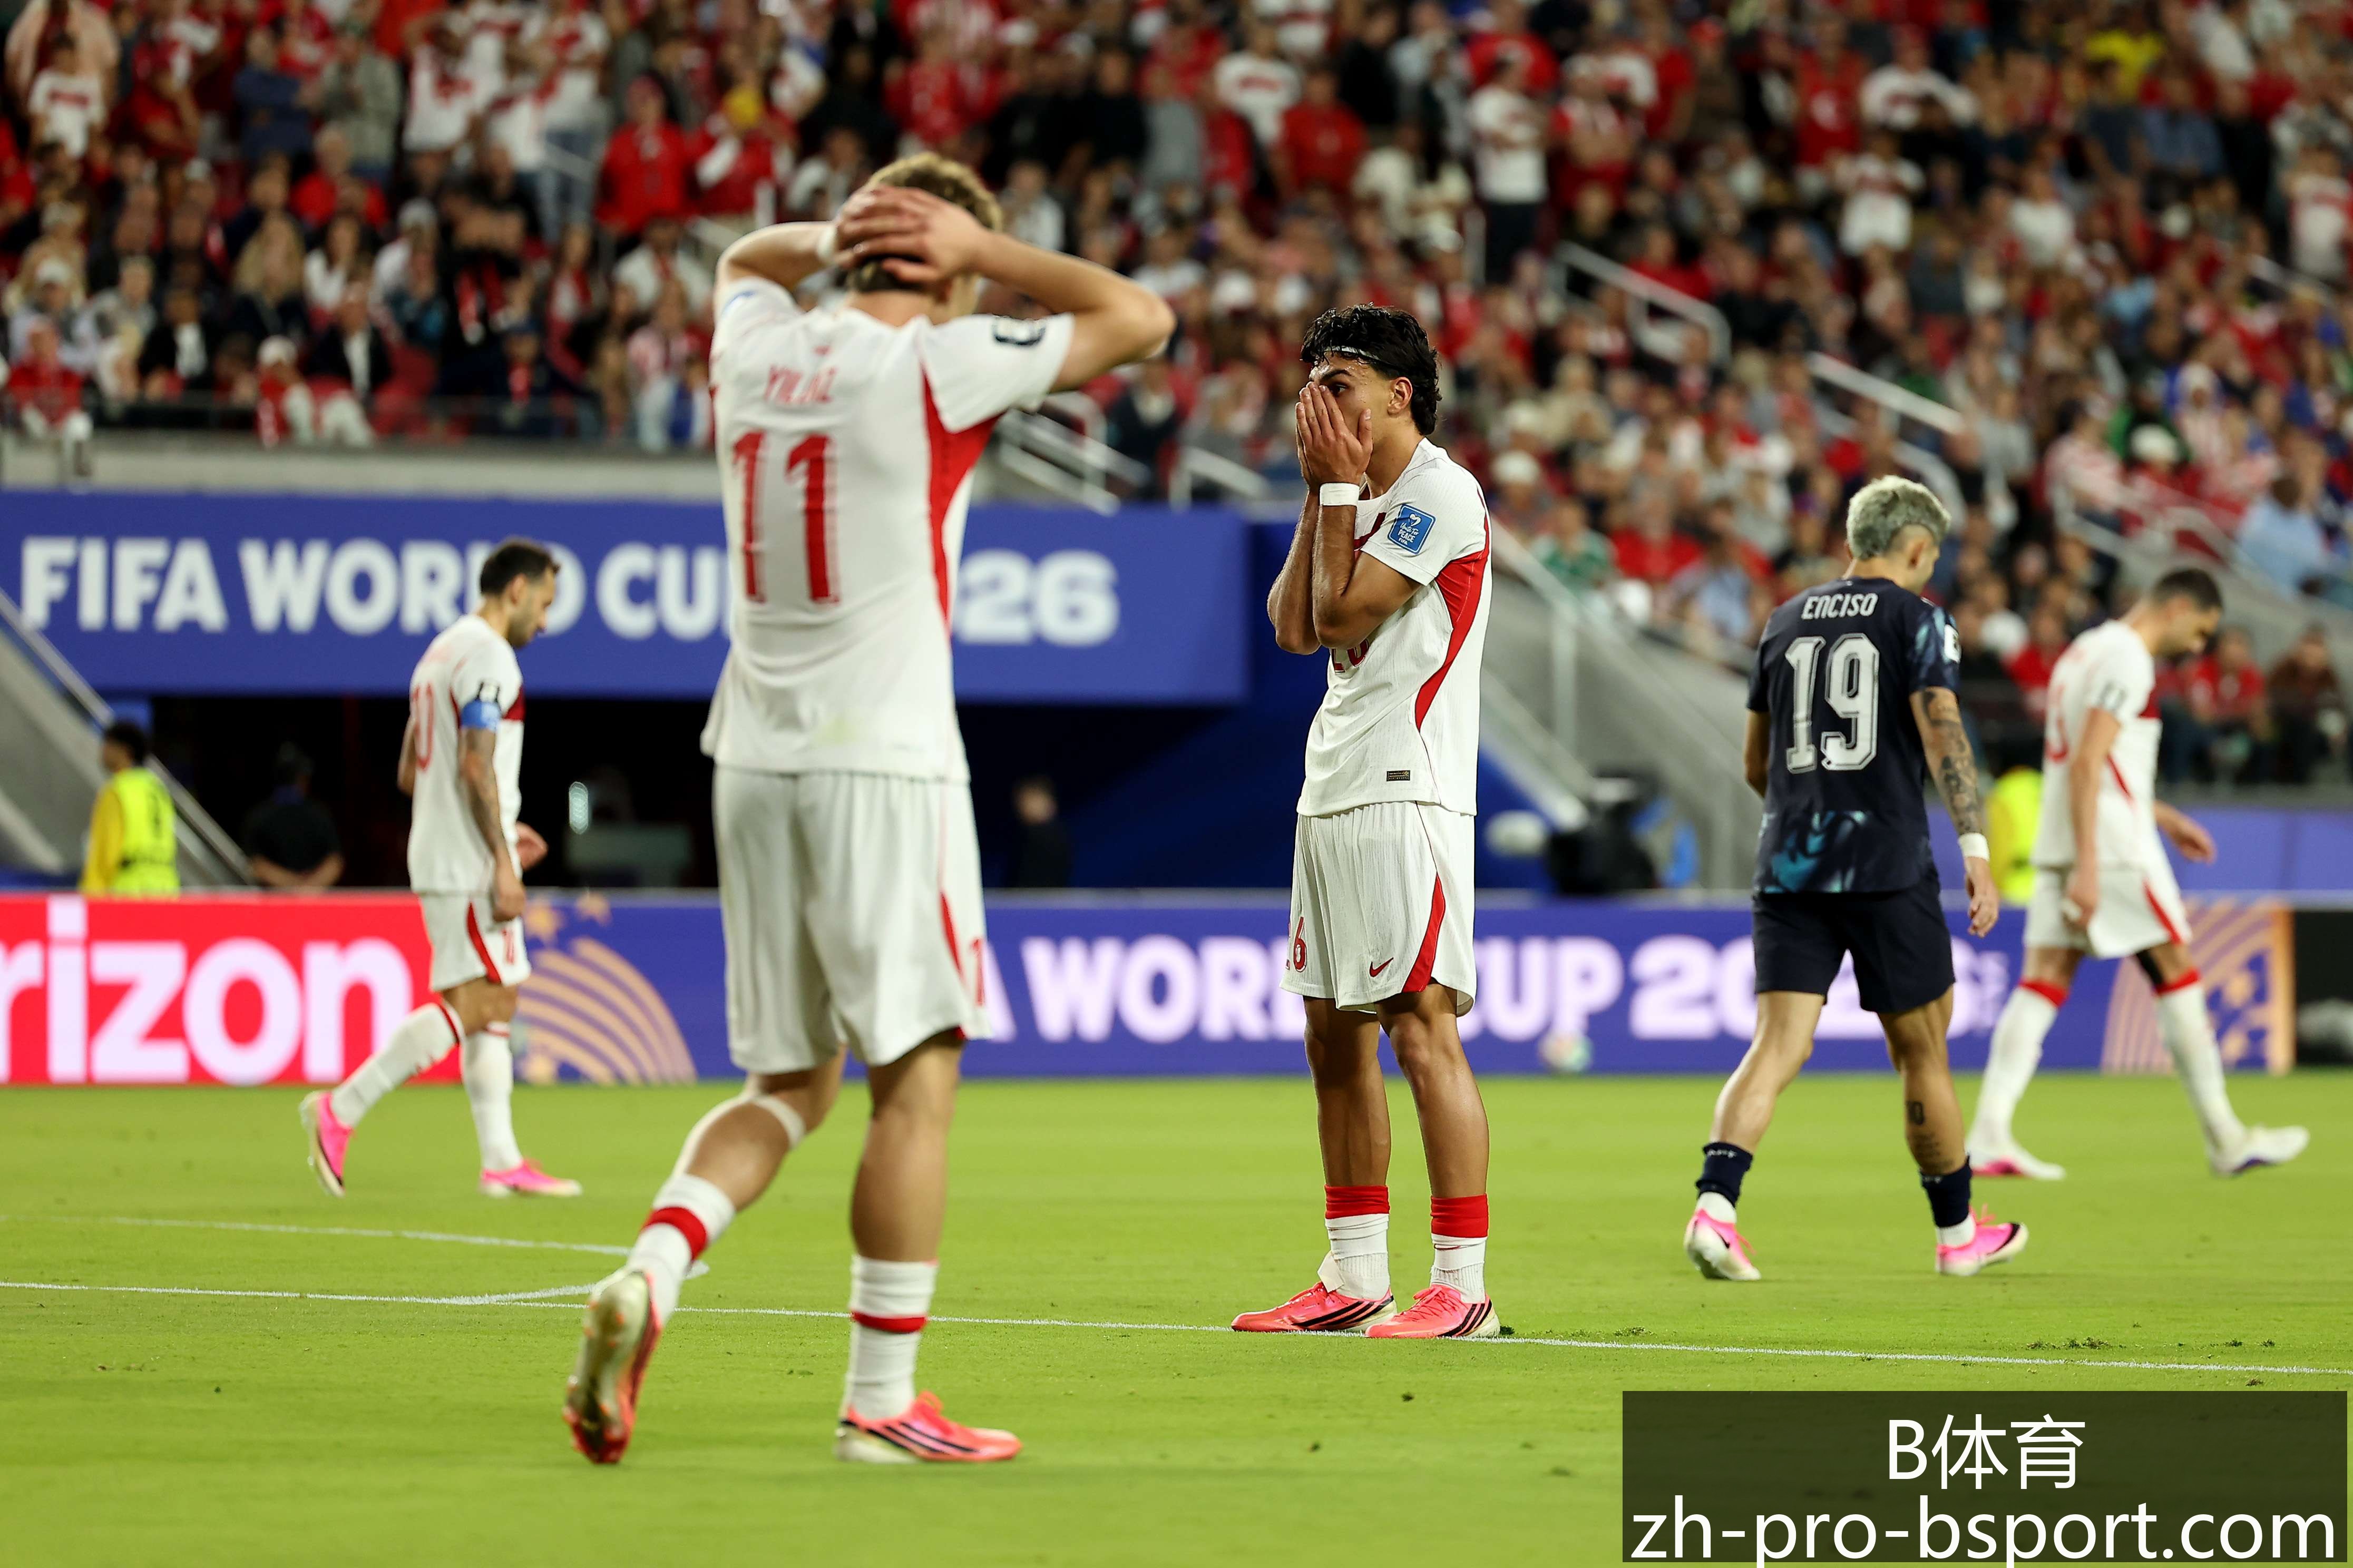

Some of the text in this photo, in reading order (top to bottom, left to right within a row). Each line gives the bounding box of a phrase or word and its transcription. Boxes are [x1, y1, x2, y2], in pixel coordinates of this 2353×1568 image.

[731, 429, 838, 603] 11
[1398, 529, 1415, 543] PEACE
[21, 536, 228, 632] FIFA
[595, 541, 731, 642] CU
[1801, 593, 1878, 620] ENCISO
[1785, 632, 1880, 775] 19
